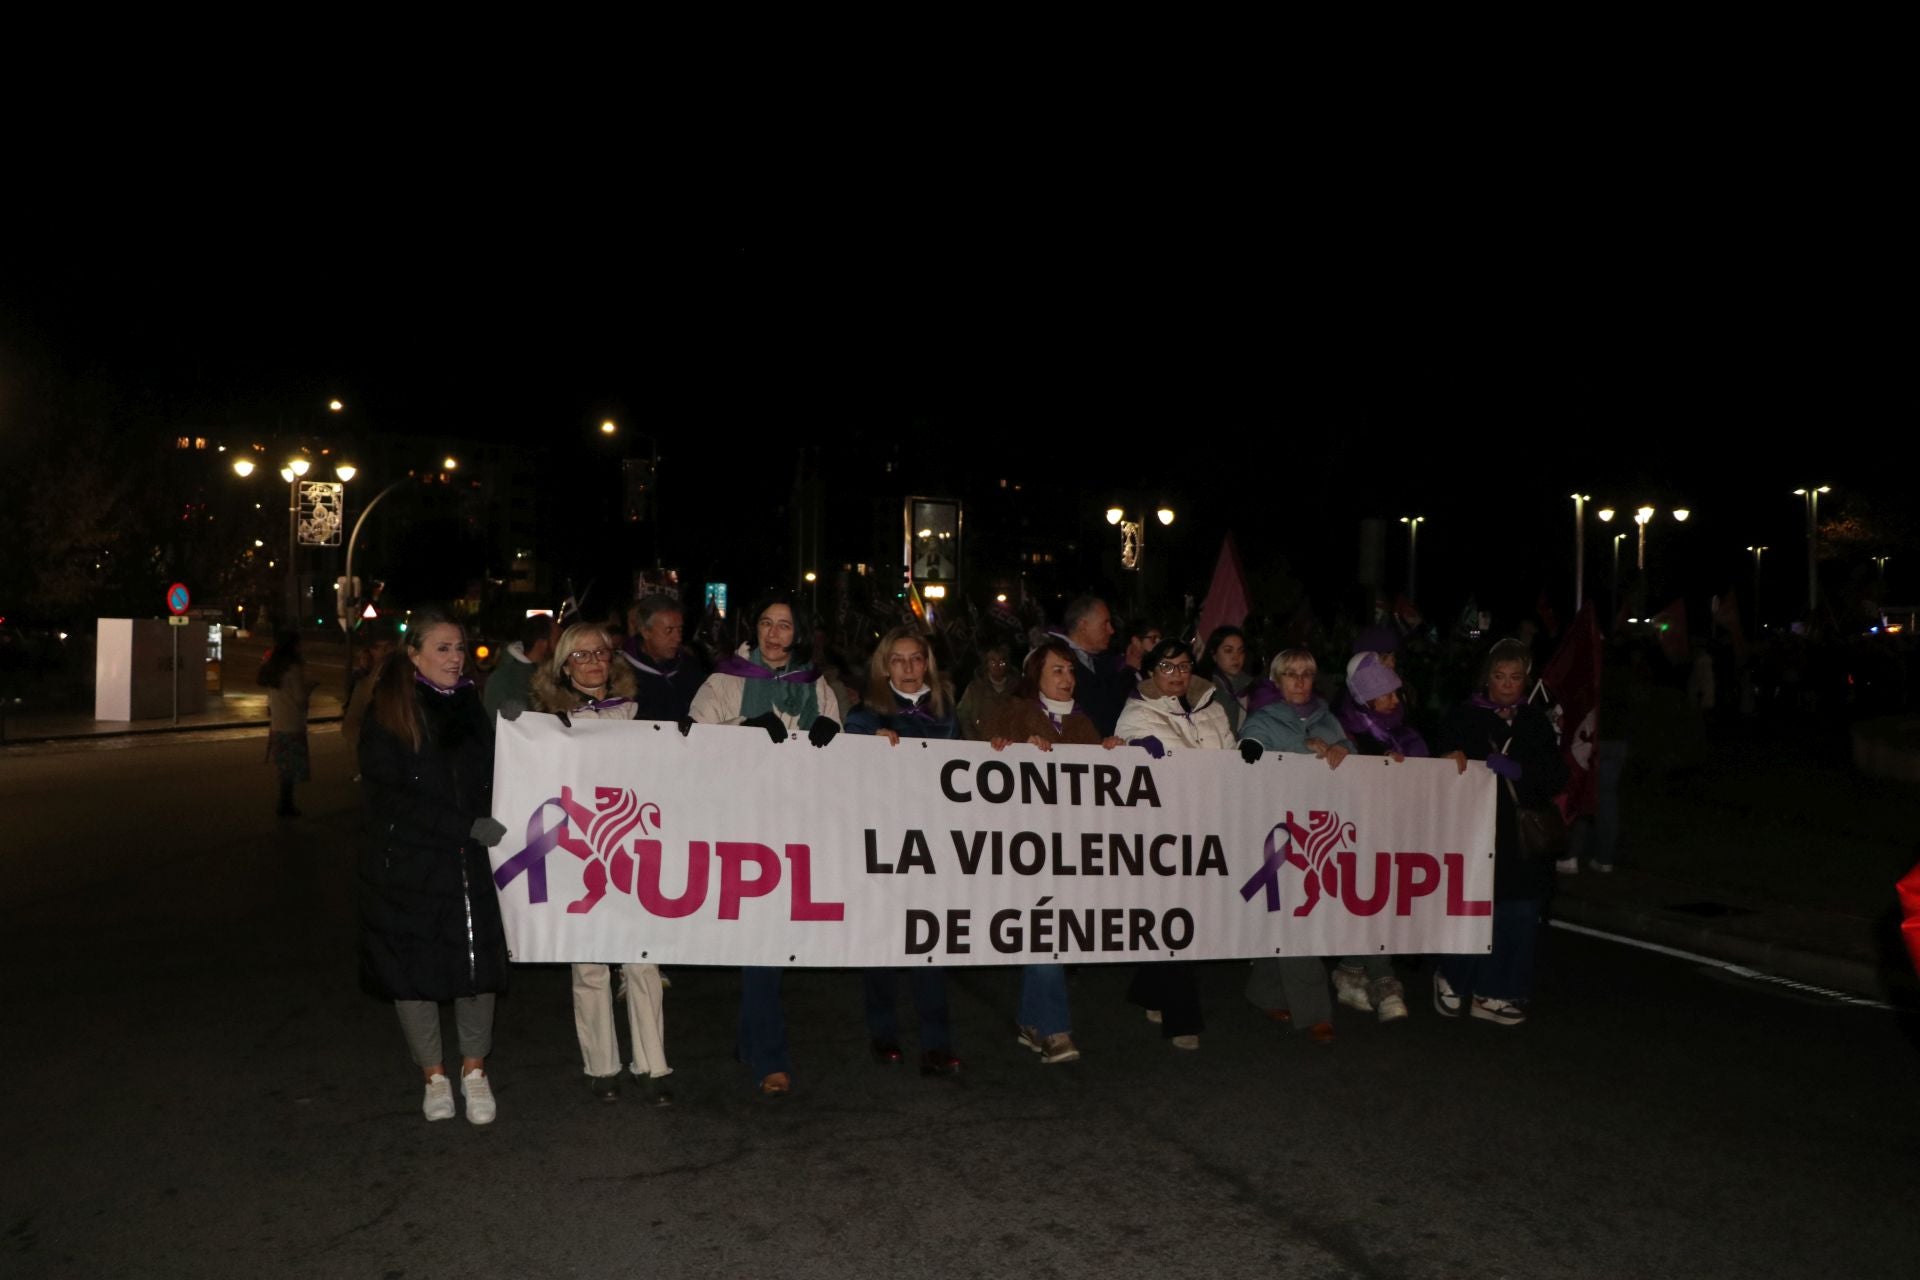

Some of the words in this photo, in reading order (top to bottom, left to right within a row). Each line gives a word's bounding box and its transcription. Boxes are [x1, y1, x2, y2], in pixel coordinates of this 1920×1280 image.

[940, 758, 1161, 807] CONTRA
[633, 839, 845, 921] UPL
[865, 829, 937, 874] LA
[950, 830, 1230, 877] VIOLENCIA
[1336, 851, 1492, 917] UPL
[905, 909, 971, 954] DE
[990, 896, 1195, 954] GÉNERO
